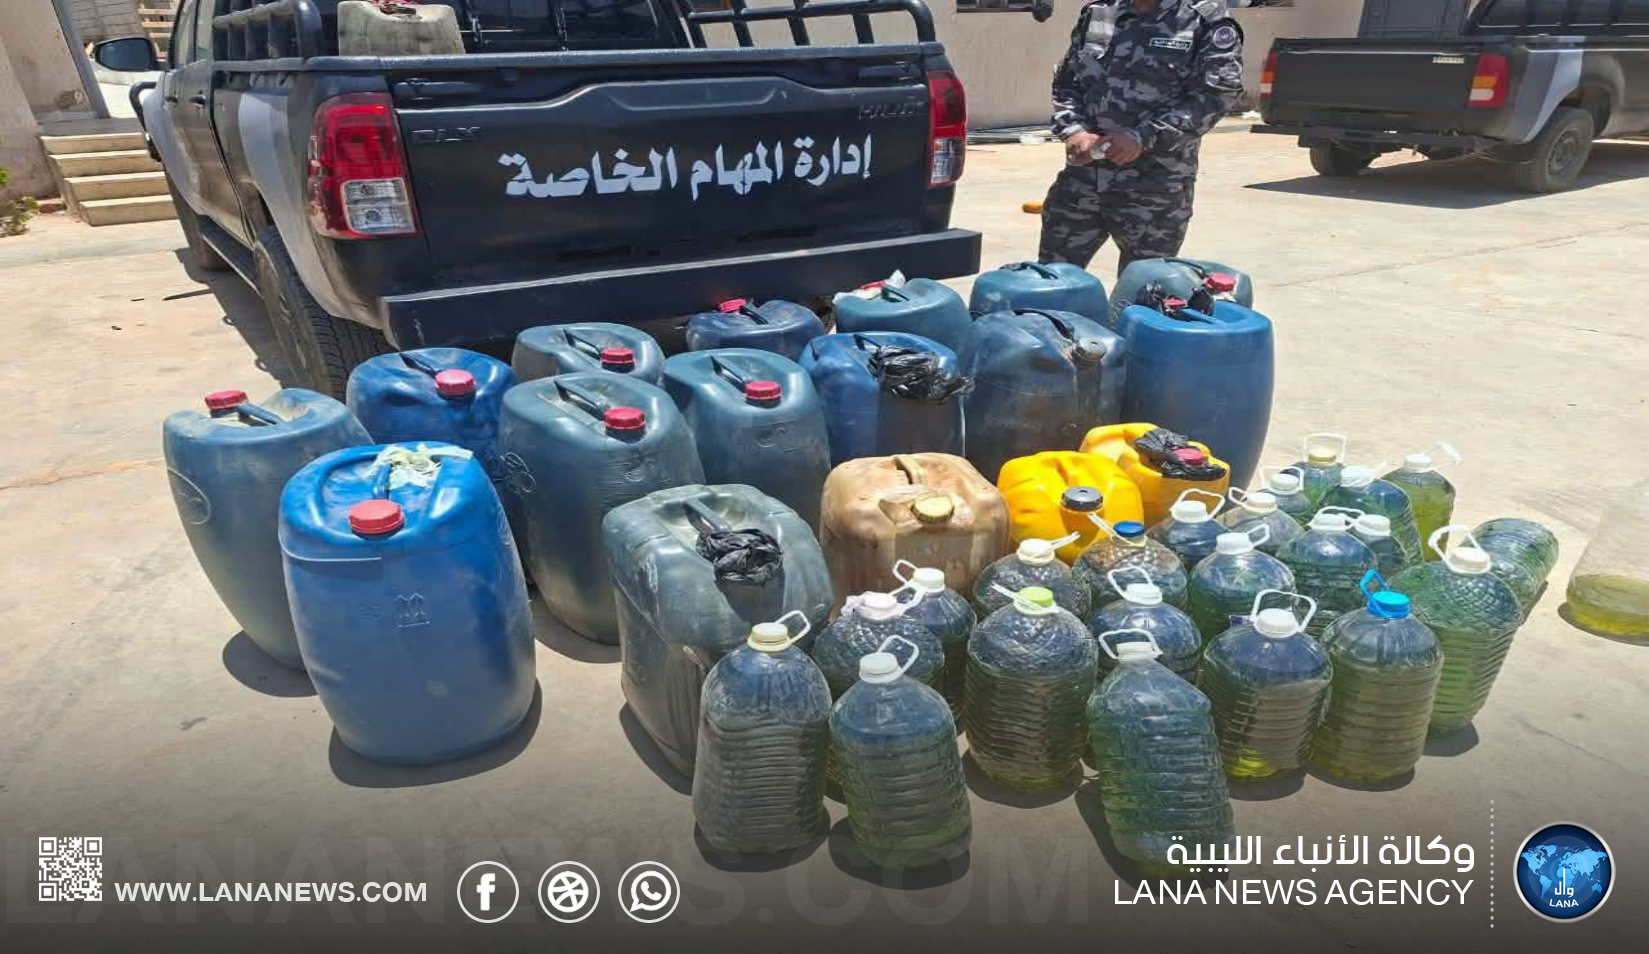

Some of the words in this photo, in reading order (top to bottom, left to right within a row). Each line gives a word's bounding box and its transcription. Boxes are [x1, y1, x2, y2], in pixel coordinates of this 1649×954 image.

[498, 146, 678, 199] الخاصة
[690, 140, 783, 201] المهام
[793, 134, 872, 187] إدارة
